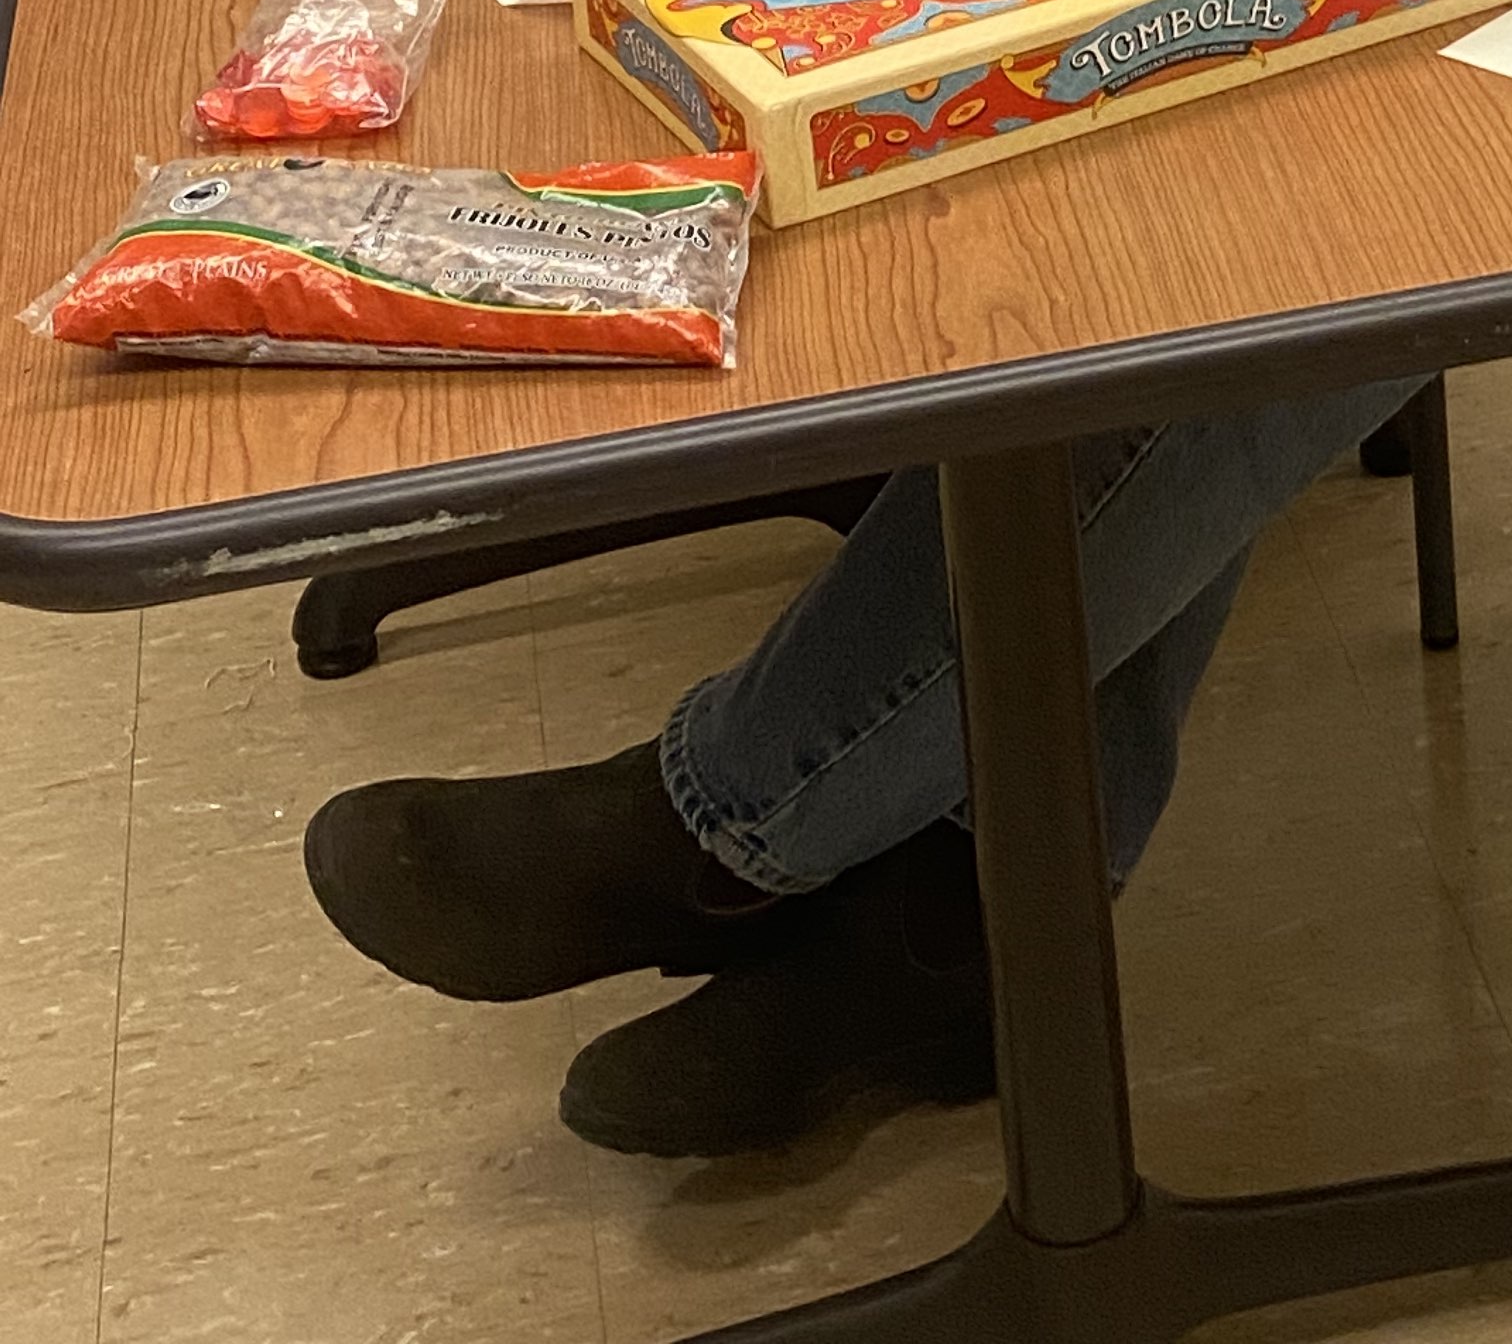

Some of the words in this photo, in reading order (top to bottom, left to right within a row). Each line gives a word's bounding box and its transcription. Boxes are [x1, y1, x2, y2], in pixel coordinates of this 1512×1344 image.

[622, 28, 709, 137] TOMBOLA
[448, 206, 592, 240] FRIJOLES
[494, 245, 572, 258] PRODUCT
[191, 257, 268, 284] PLAINS
